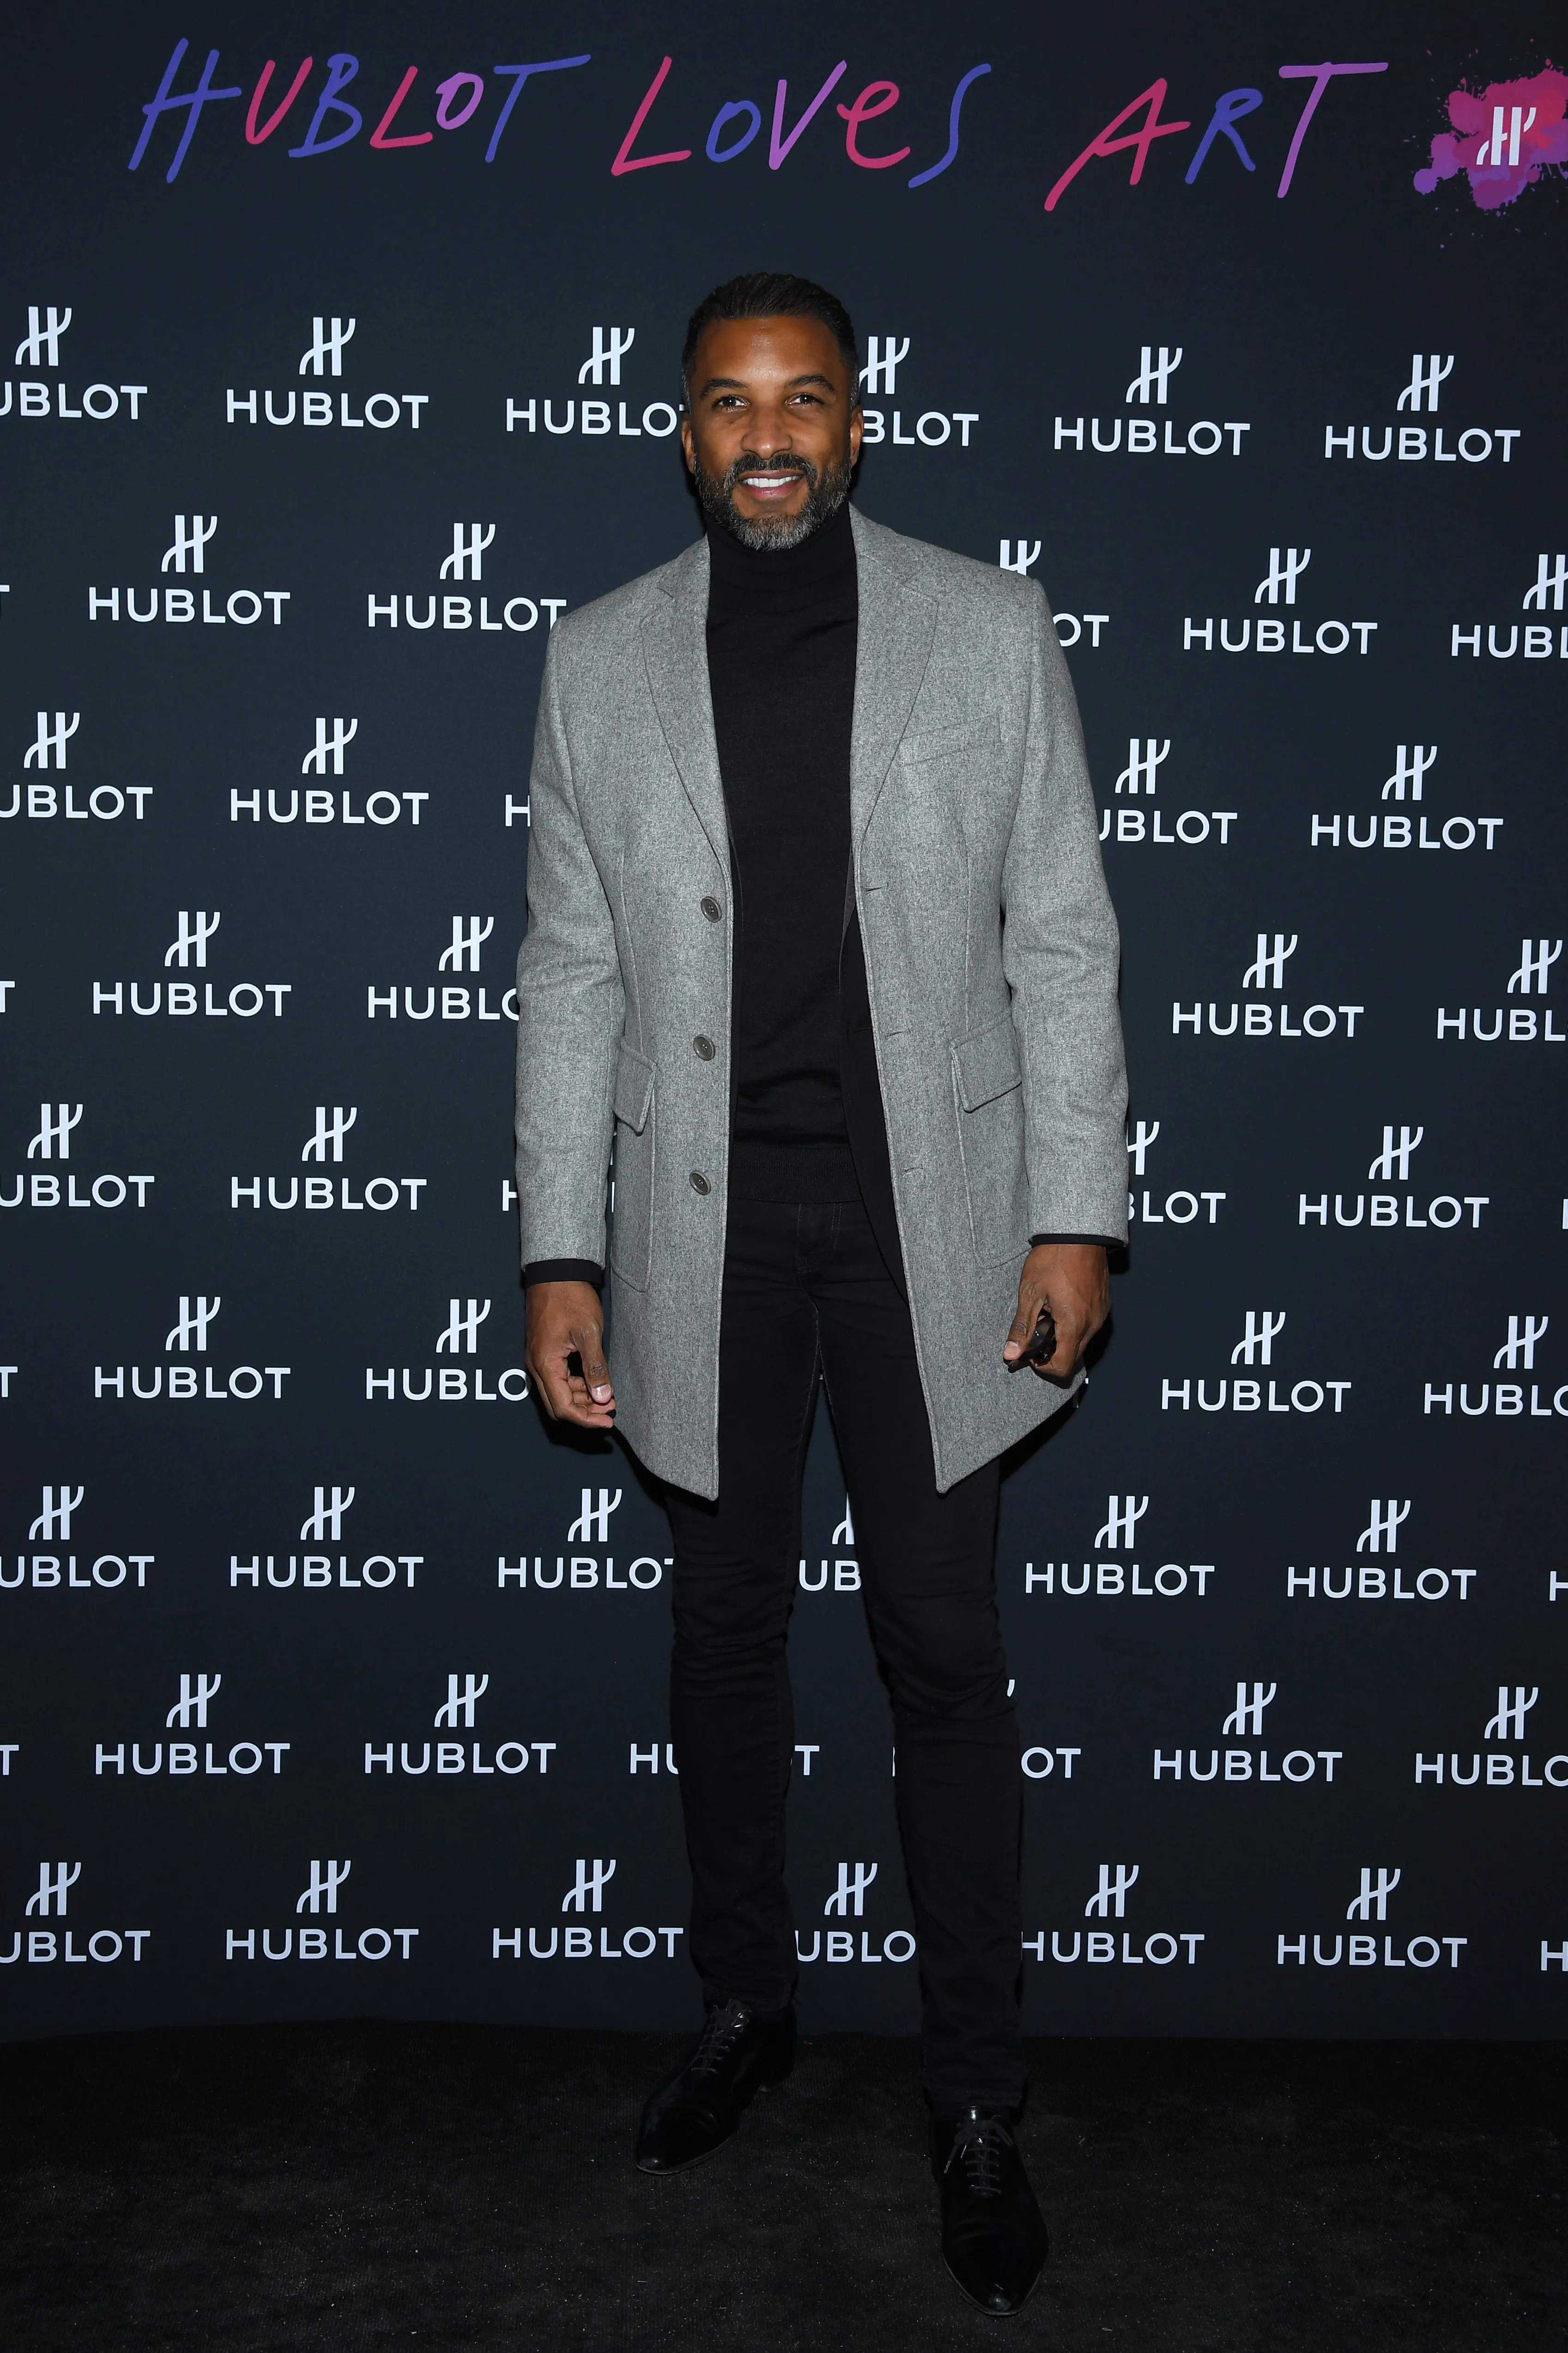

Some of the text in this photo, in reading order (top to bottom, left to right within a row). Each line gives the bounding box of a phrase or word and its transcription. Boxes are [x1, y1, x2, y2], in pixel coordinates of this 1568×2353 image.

[128, 38, 591, 183] HUBLOT
[1045, 62, 1388, 211] ART
[227, 389, 429, 428] HUBLOT
[507, 399, 684, 437] HUBLO
[1054, 417, 1250, 455] HUBLOT
[1325, 426, 1520, 462] HUBLOT
[89, 587, 290, 625] HUBLOT
[369, 594, 566, 631] HUBLOT
[1184, 618, 1377, 654] HUBLOT
[231, 789, 429, 825] HUBLOT
[1312, 815, 1503, 849] HUBLOT
[93, 982, 291, 1016] HUBLOT
[1173, 1002, 1364, 1037] HUBLOT
[232, 1176, 427, 1210] HUBLOT
[1299, 1195, 1489, 1228] HUBLOT
[95, 1366, 291, 1399] HUBLOT
[1162, 1379, 1351, 1412] HUBLOT
[231, 1556, 424, 1587] HUBLOT
[498, 1557, 673, 1589] HUBLO
[1026, 1563, 1215, 1595] HUBLOT
[1288, 1567, 1476, 1600] HUBLOT
[96, 1743, 290, 1775] HUBLOT
[365, 1742, 556, 1774] HUBLOT
[1154, 1750, 1342, 1782] HUBLOT
[226, 1928, 418, 1959] HUBLOT
[493, 1927, 683, 1958] HUBLOT
[1022, 1931, 1205, 1964] HUBLOT
[1278, 1935, 1467, 1967] HUBLOT
